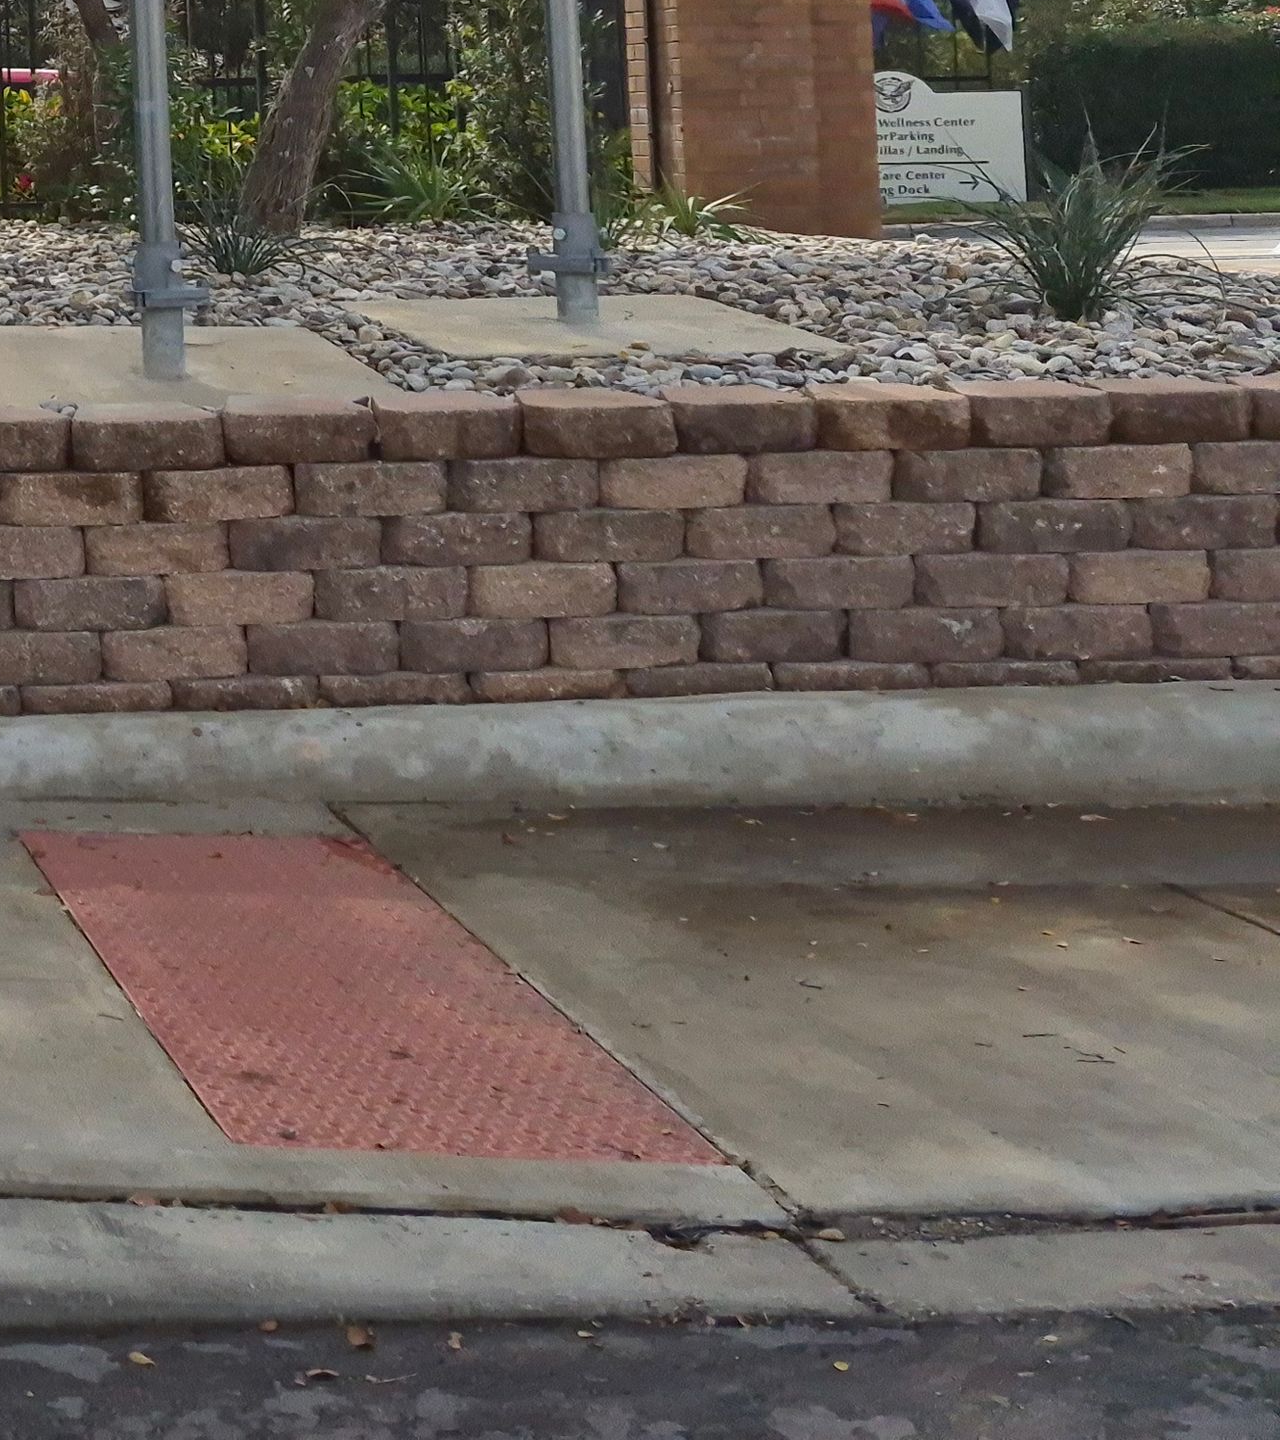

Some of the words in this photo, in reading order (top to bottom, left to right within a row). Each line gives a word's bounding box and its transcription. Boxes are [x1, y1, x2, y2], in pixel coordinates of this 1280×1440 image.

[878, 116, 931, 128] Wellness
[934, 116, 976, 128] Center
[877, 144, 905, 156] illas
[916, 143, 964, 157] Landing
[880, 172, 902, 181] are
[905, 170, 945, 181] Center
[898, 183, 930, 195] Dock
